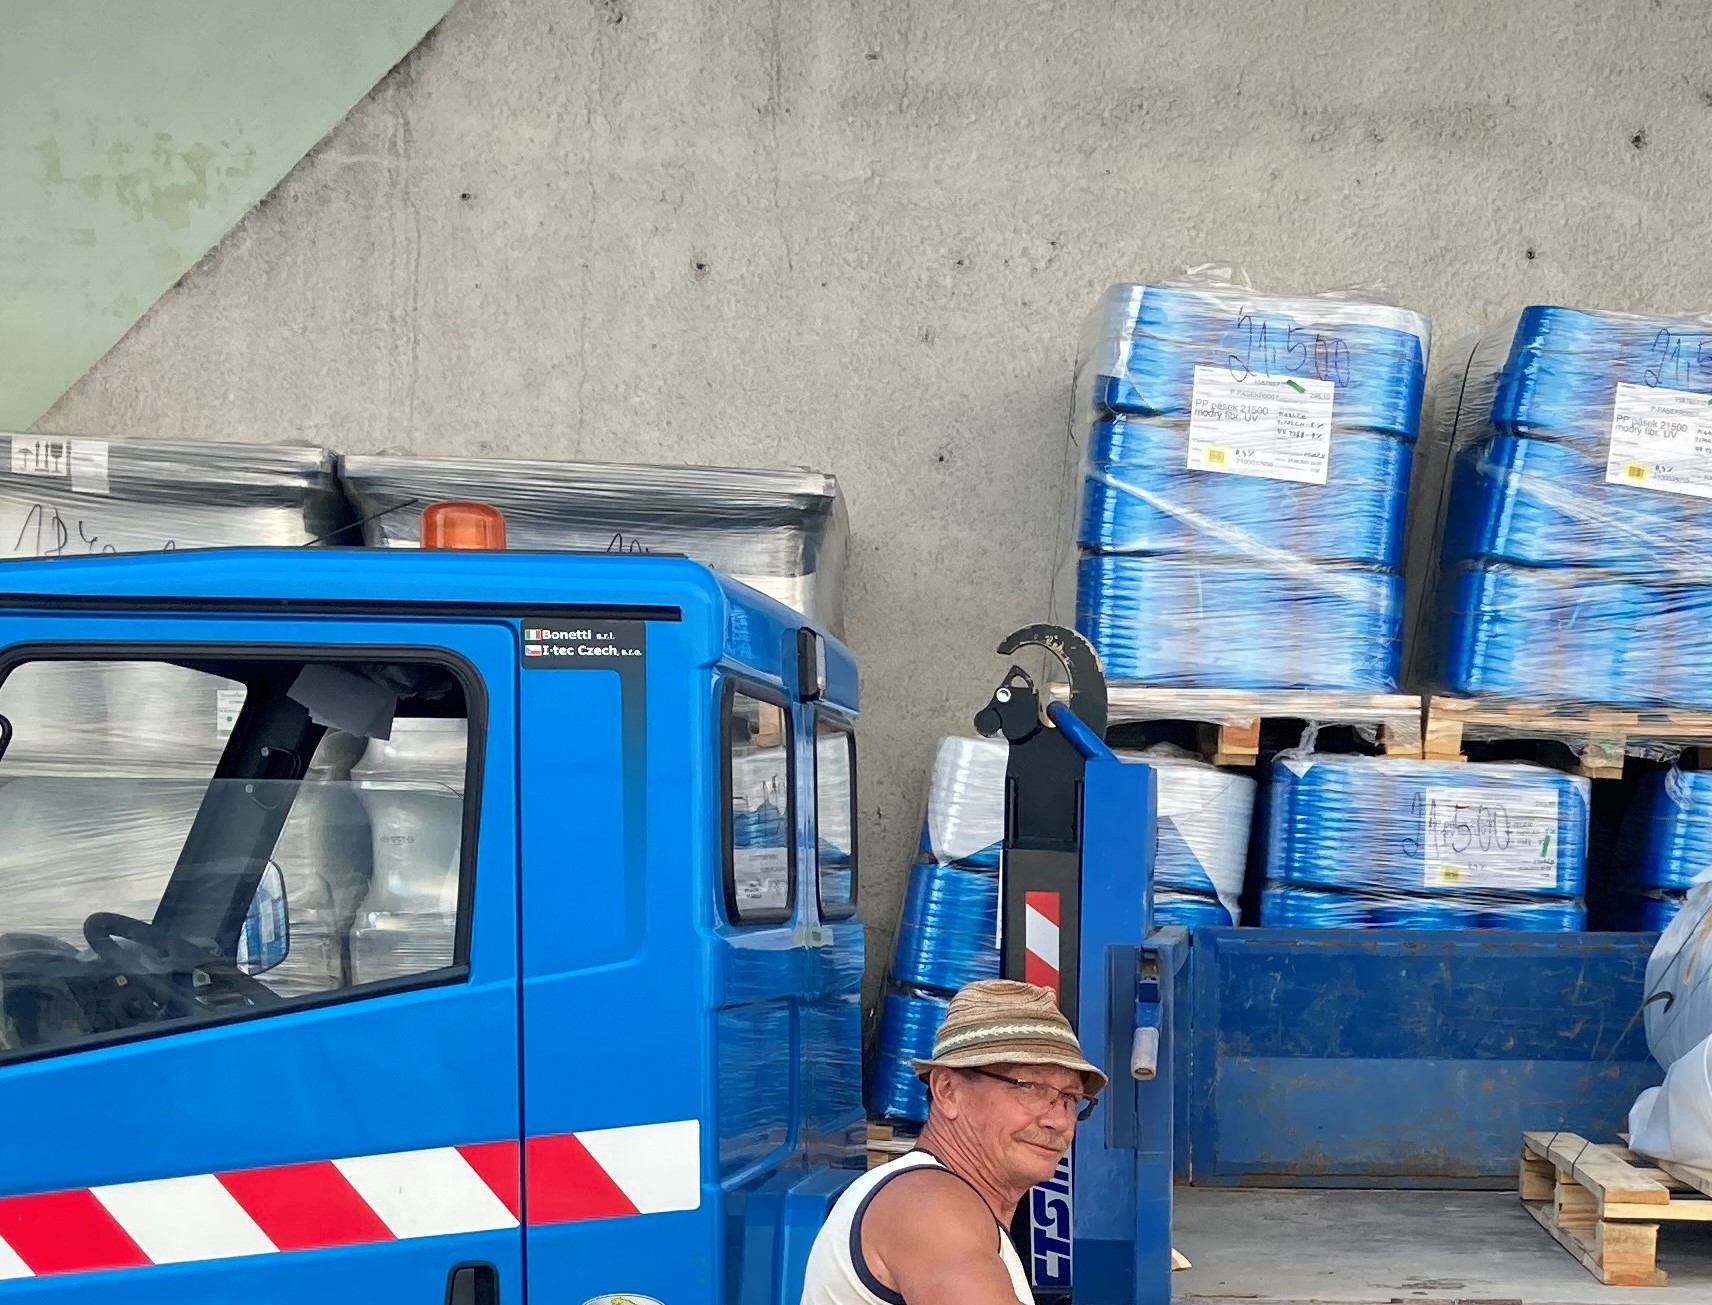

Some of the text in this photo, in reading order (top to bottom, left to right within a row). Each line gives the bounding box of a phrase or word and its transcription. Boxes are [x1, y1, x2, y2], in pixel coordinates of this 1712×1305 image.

[1195, 398, 1209, 408] PP
[1244, 412, 1259, 423] UV
[1616, 415, 1631, 424] PP
[1659, 421, 1688, 433] 21500
[1663, 430, 1679, 440] UV
[542, 629, 592, 640] Bonetti
